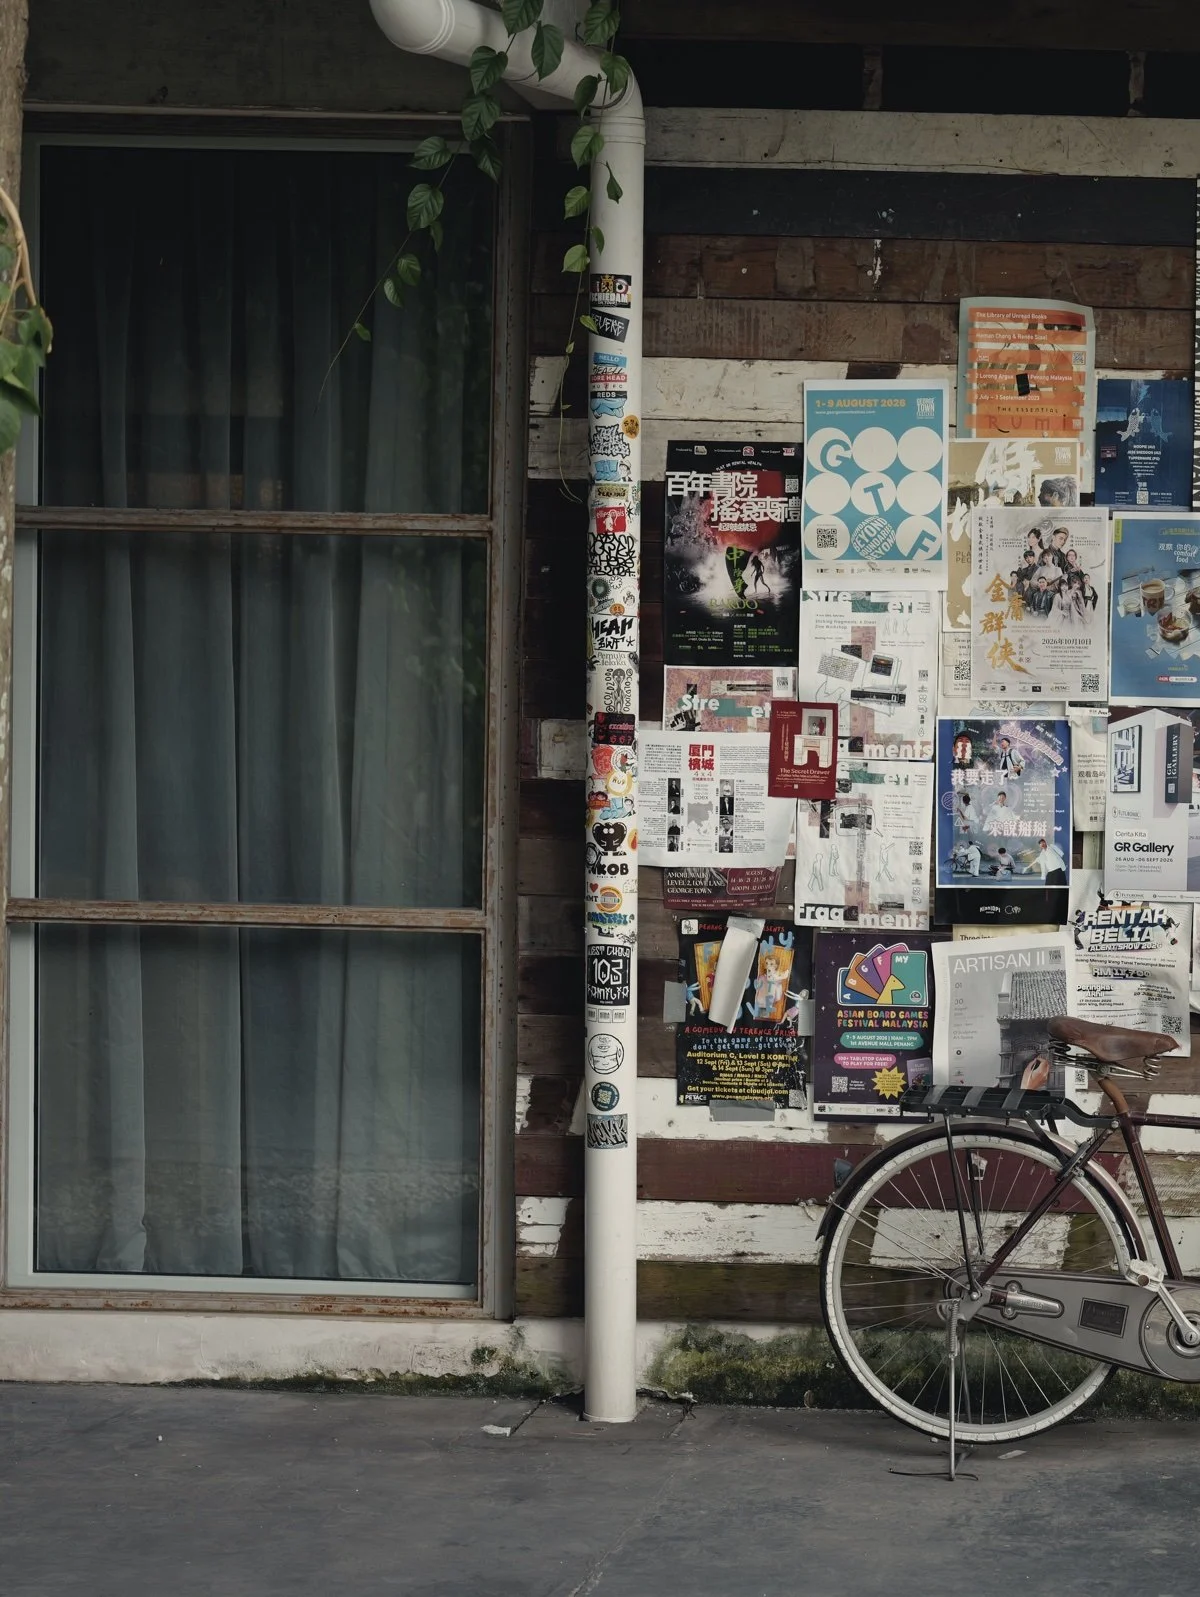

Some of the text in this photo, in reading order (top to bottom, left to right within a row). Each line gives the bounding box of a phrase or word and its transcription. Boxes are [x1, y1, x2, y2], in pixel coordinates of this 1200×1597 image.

[836, 399, 879, 407] AUGUST
[666, 471, 758, 497] 百年書院
[681, 694, 720, 711] Stre
[864, 741, 933, 759] ments
[1114, 842, 1174, 856] GR Gallery
[1090, 926, 1154, 944] BELIA
[895, 955, 908, 964] MY
[953, 951, 1037, 975] ARTISAN
[837, 1010, 928, 1019] ASIAN BOARD GAMES
[837, 1020, 928, 1028] FESTIVAL MALAYSIA
[687, 1051, 727, 1059] Auditorium
